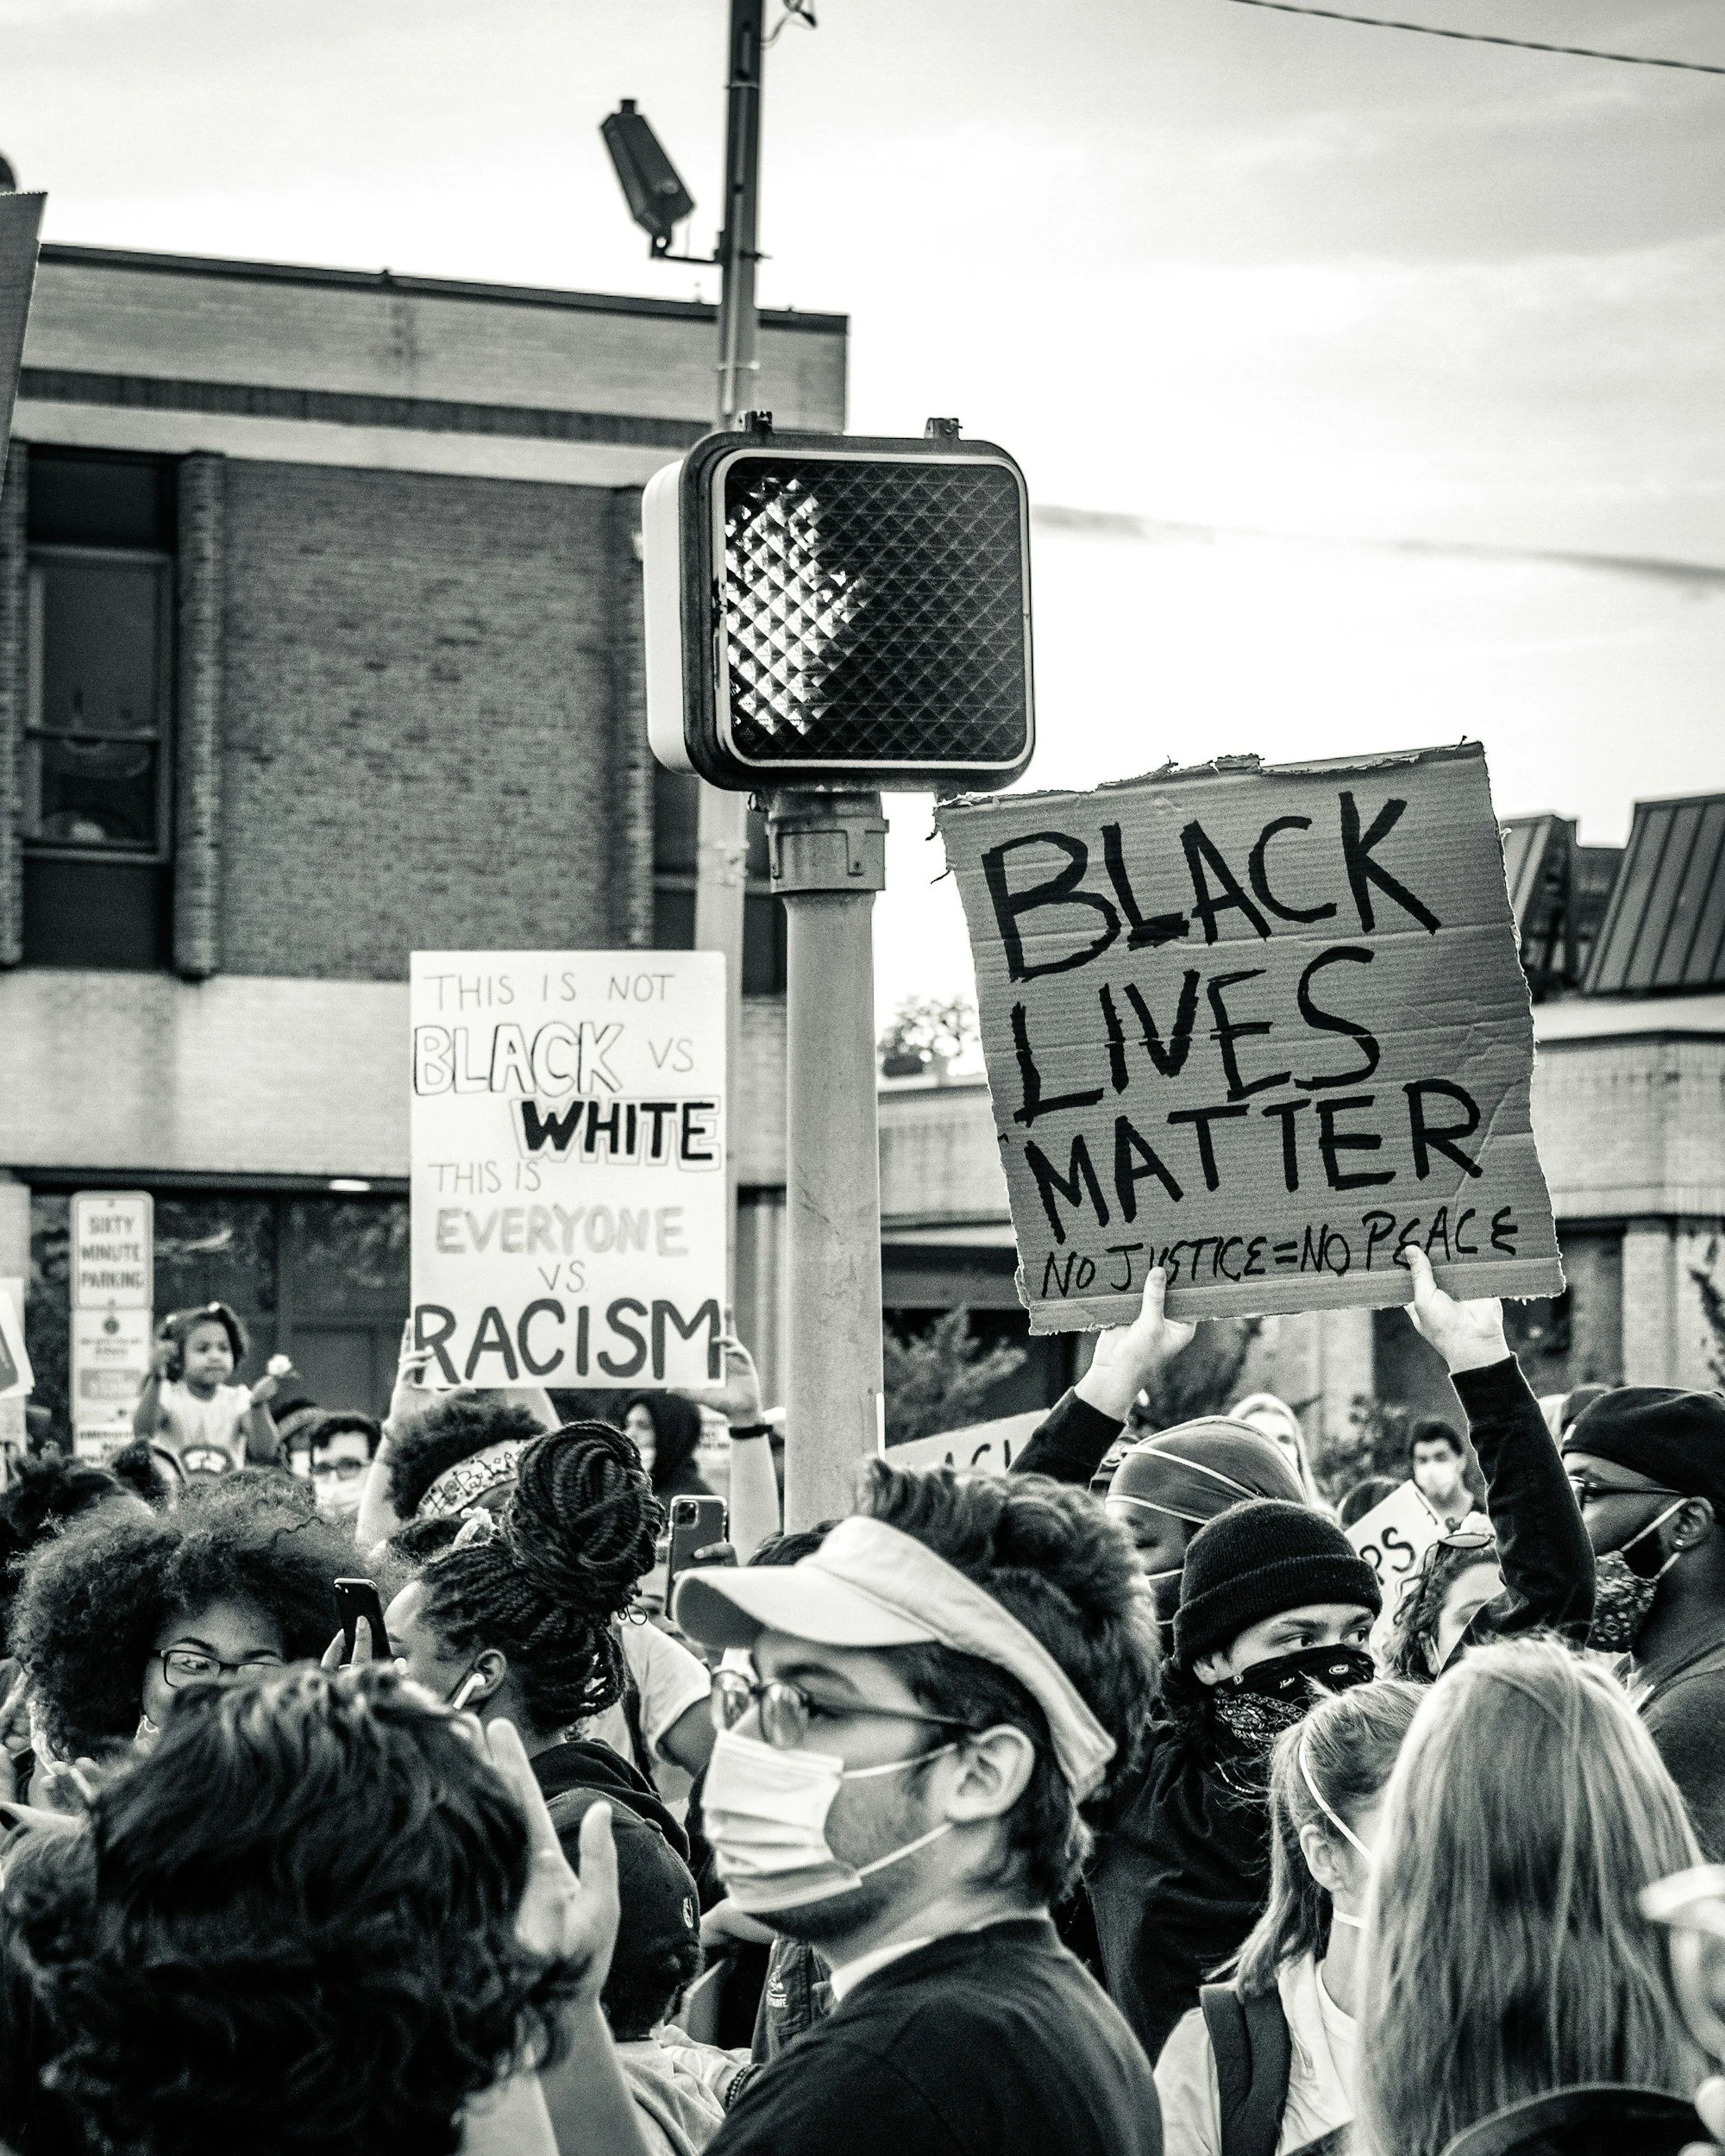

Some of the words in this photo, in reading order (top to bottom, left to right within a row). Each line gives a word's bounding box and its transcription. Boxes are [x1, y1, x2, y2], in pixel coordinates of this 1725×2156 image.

[980, 791, 1441, 982] BLACK
[423, 974, 515, 1012] THIS
[543, 972, 576, 1002] IS
[608, 972, 675, 1002] NOT
[413, 1021, 624, 1099] BLACK
[1009, 945, 1382, 1129] LIVES
[515, 1098, 718, 1167] WHITE
[1024, 1079, 1484, 1244] MATTER
[428, 1161, 502, 1194] THIS
[515, 1161, 542, 1192] IS
[436, 1204, 689, 1257] EVERYONE
[1041, 1251, 1096, 1298] NO
[1362, 1206, 1519, 1272] PEACE
[80, 1270, 143, 1290] PARKING
[414, 1297, 721, 1385] RACISM
